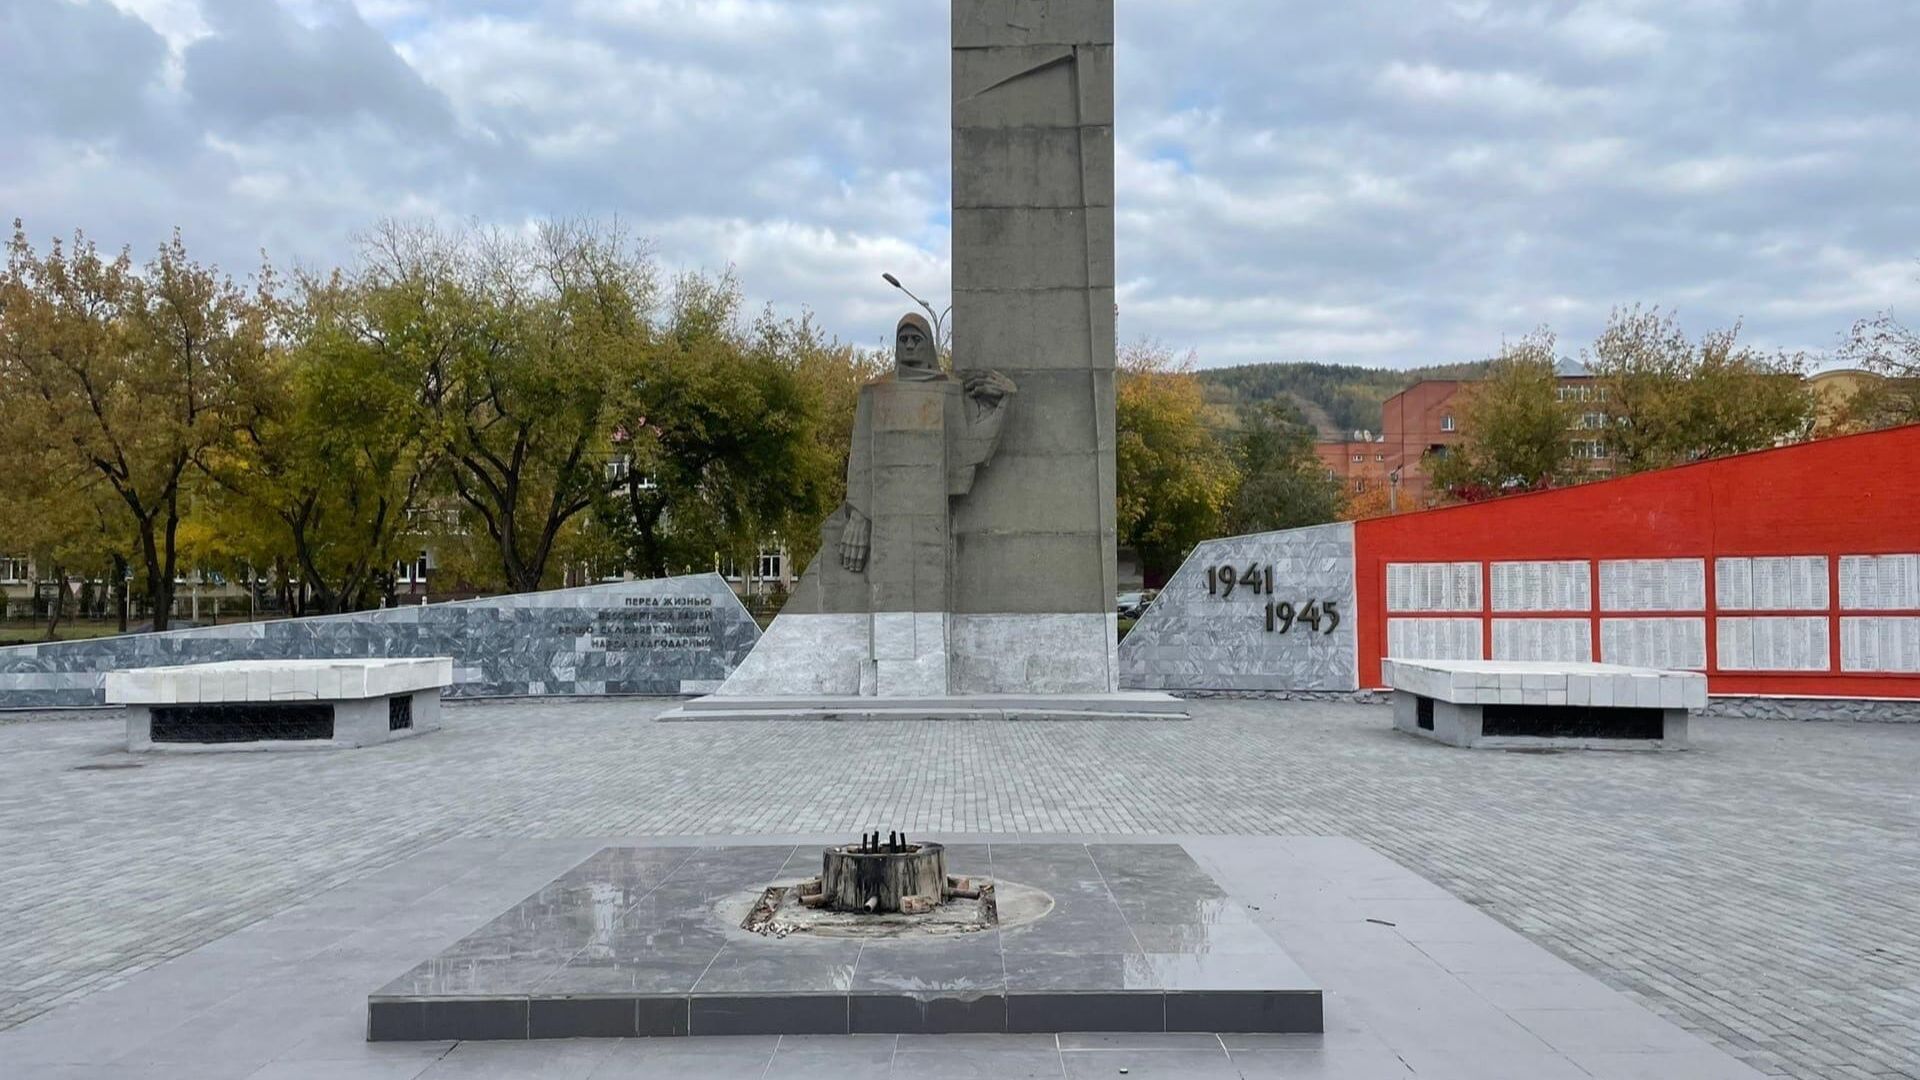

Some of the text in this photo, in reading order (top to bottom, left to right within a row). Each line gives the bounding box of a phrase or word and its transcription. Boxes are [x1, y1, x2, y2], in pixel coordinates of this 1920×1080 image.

[1207, 562, 1273, 597] 1941
[625, 597, 712, 606] ПЕРЕД ЖИЗНЬЮ
[1265, 598, 1340, 634] 1945
